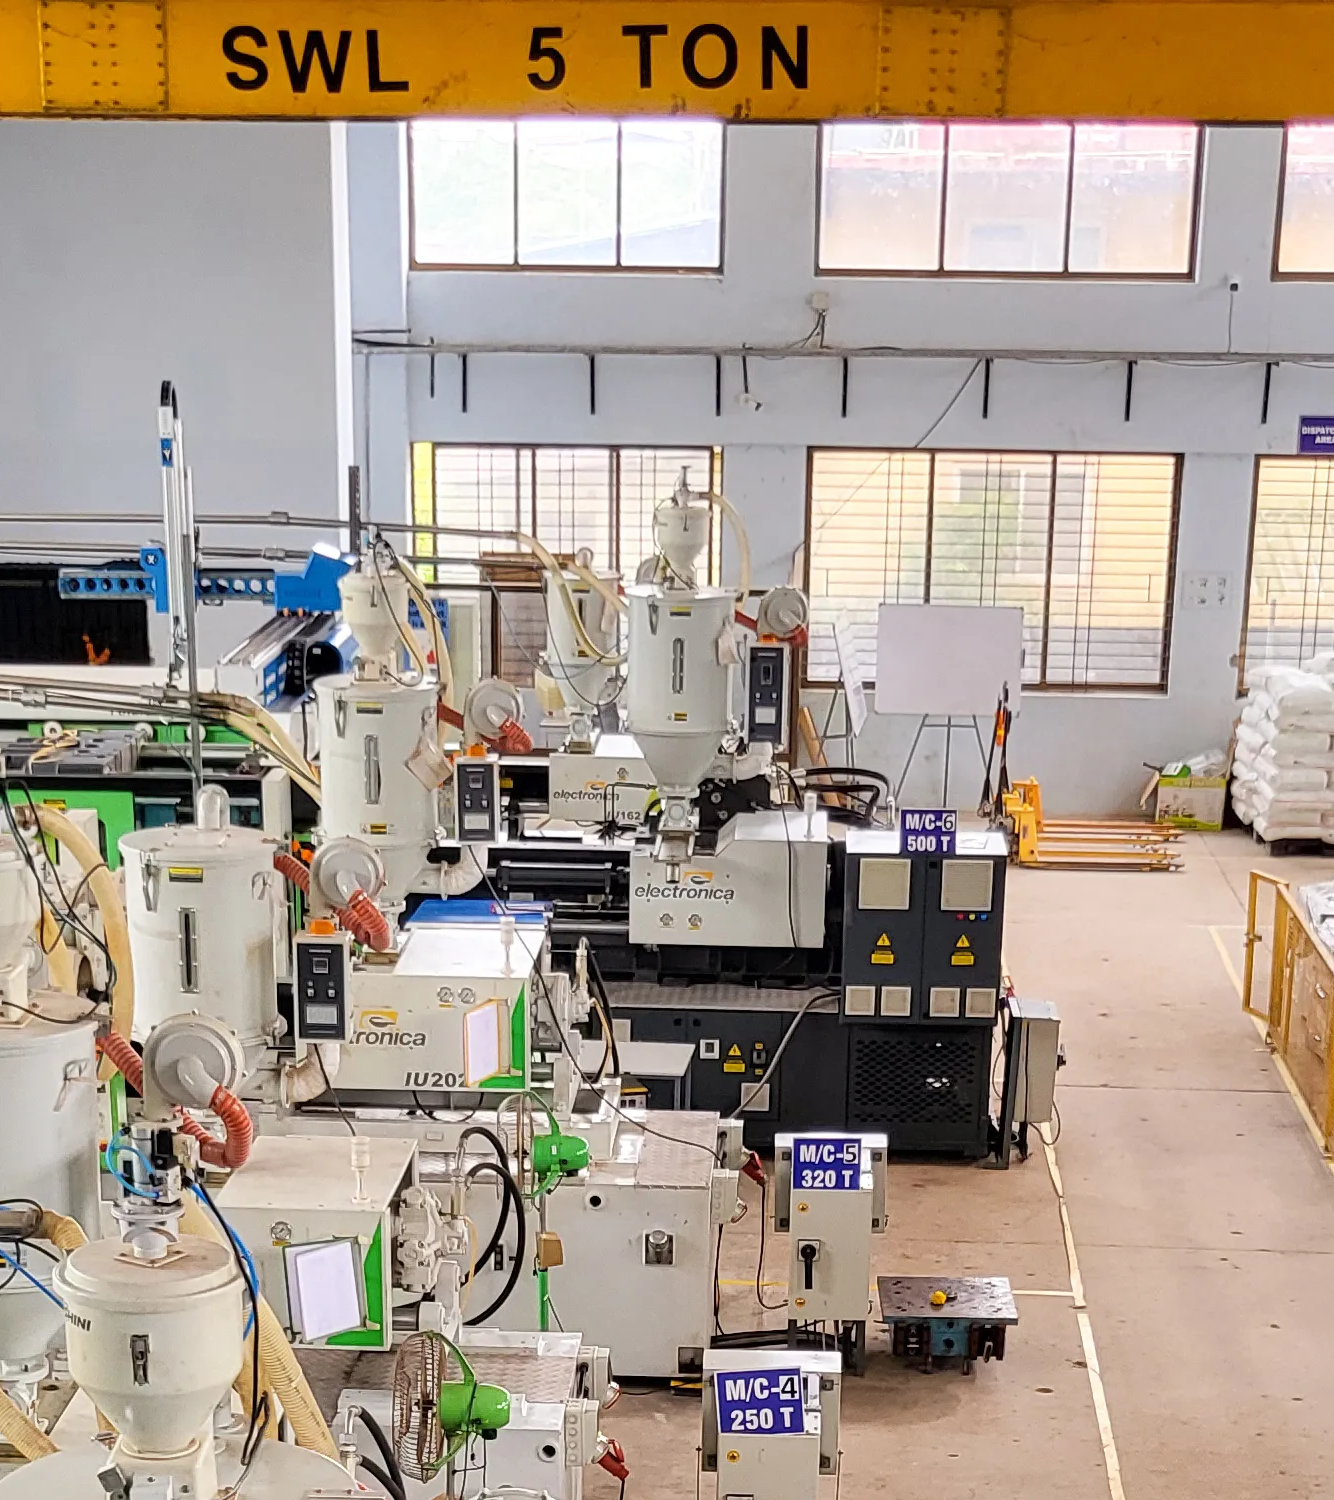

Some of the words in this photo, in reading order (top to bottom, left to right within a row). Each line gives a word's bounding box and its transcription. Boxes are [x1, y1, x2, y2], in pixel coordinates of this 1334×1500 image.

[221, 25, 410, 93] SWL
[526, 27, 566, 91] 5
[621, 24, 809, 91] TON
[905, 813, 955, 831] M/C-6
[907, 836, 938, 852] 500
[940, 835, 951, 852] T
[634, 884, 735, 902] electronica
[350, 1031, 426, 1047] ronica
[800, 1144, 857, 1164] M/C-5
[801, 1170, 836, 1187] 320
[842, 1170, 853, 1187] T
[725, 1377, 797, 1402] M/C-4
[730, 1408, 774, 1430] 250
[780, 1406, 794, 1428] T
